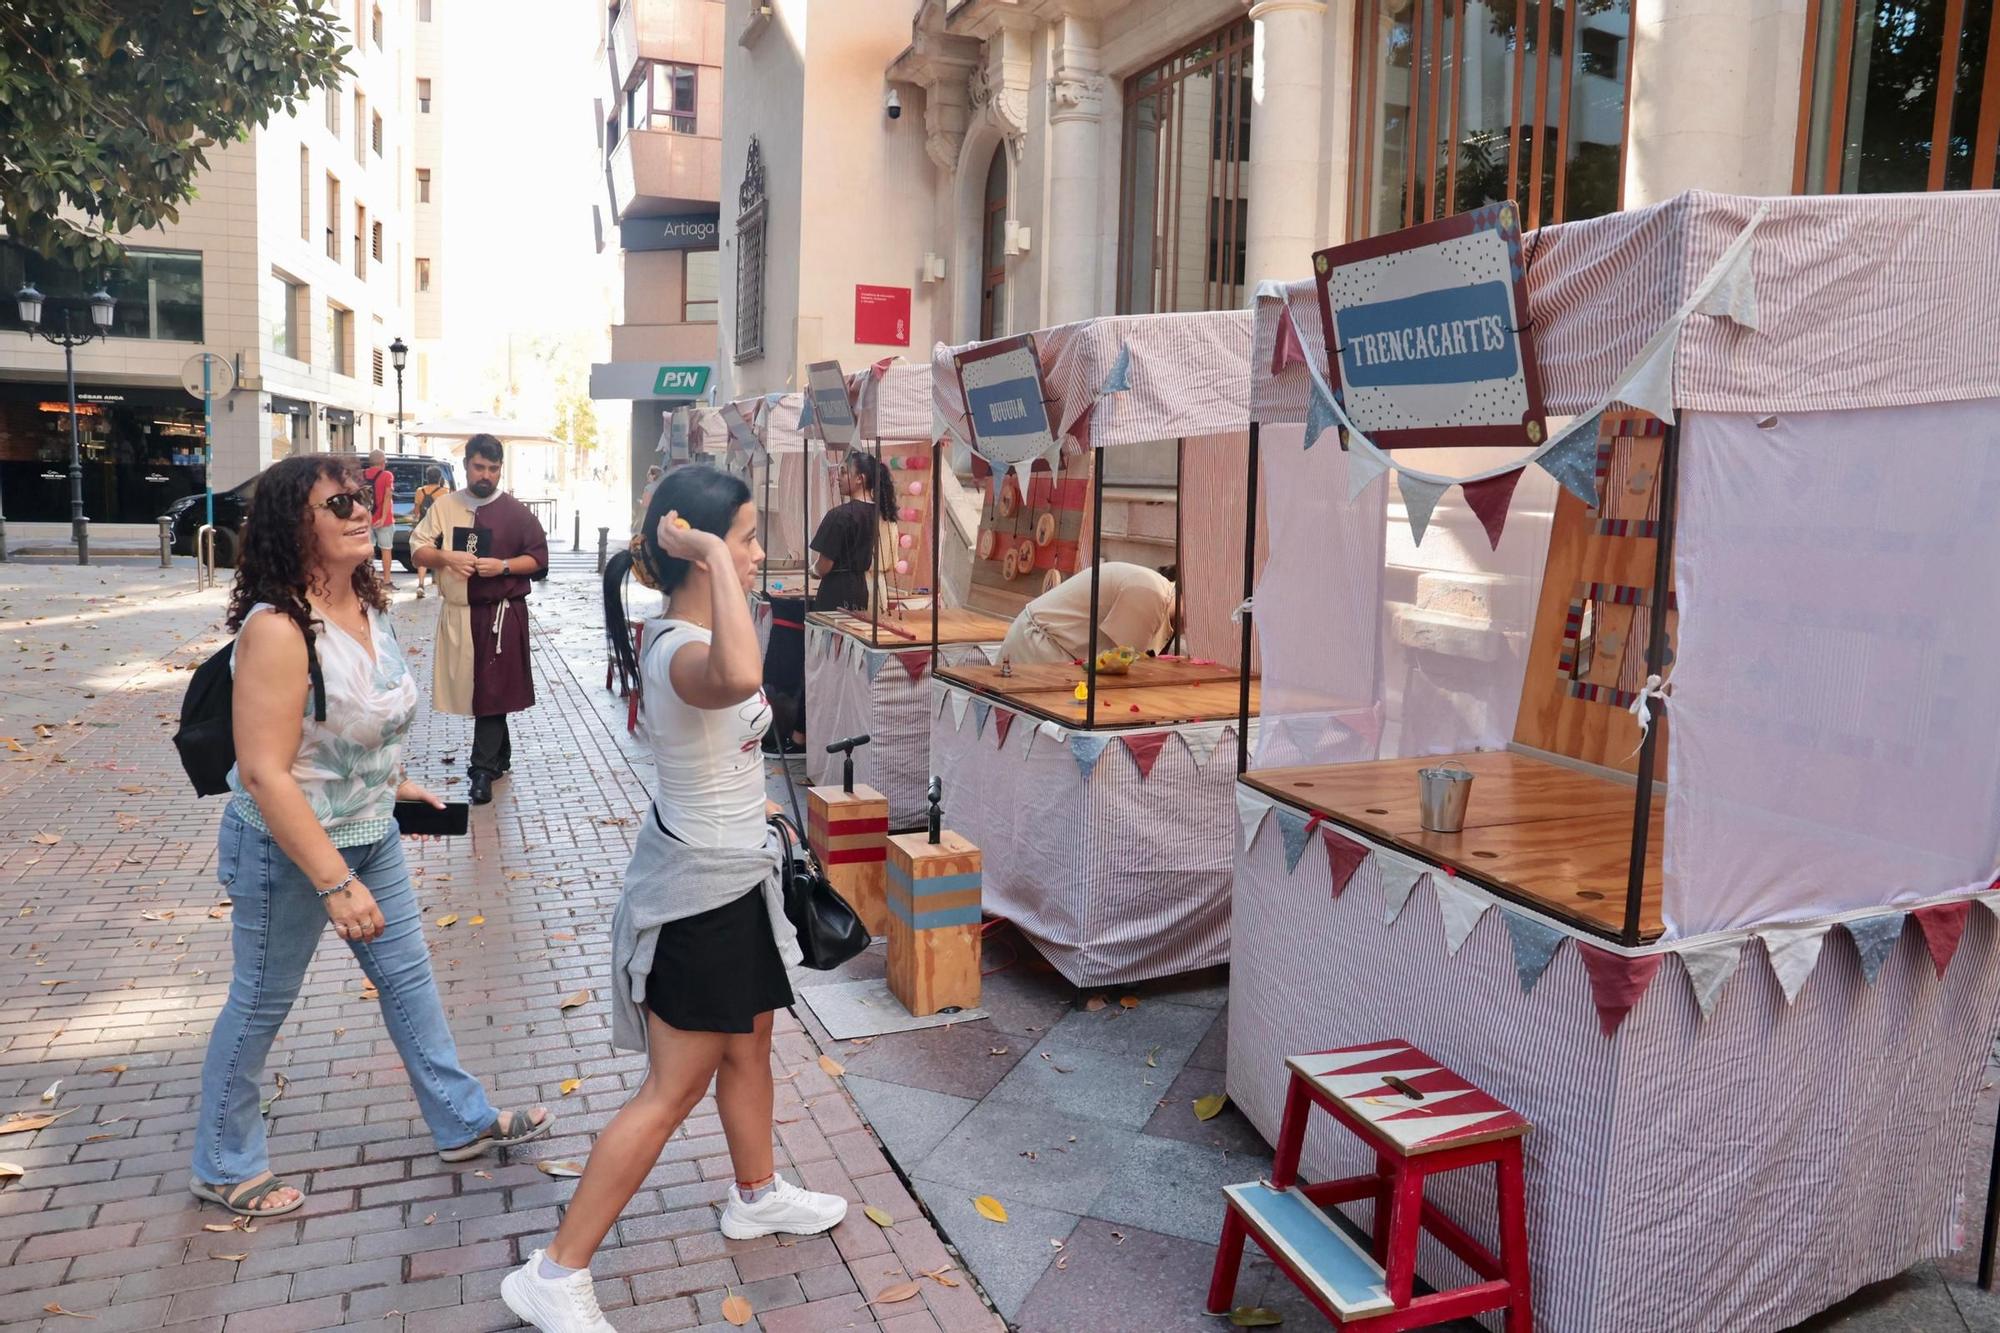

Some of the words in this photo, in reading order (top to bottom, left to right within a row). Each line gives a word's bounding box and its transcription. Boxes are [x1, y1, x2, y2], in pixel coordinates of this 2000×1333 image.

[664, 221, 715, 240] Artiaga
[1348, 315, 1505, 367] TRENCACARTES
[662, 372, 698, 387] PSN
